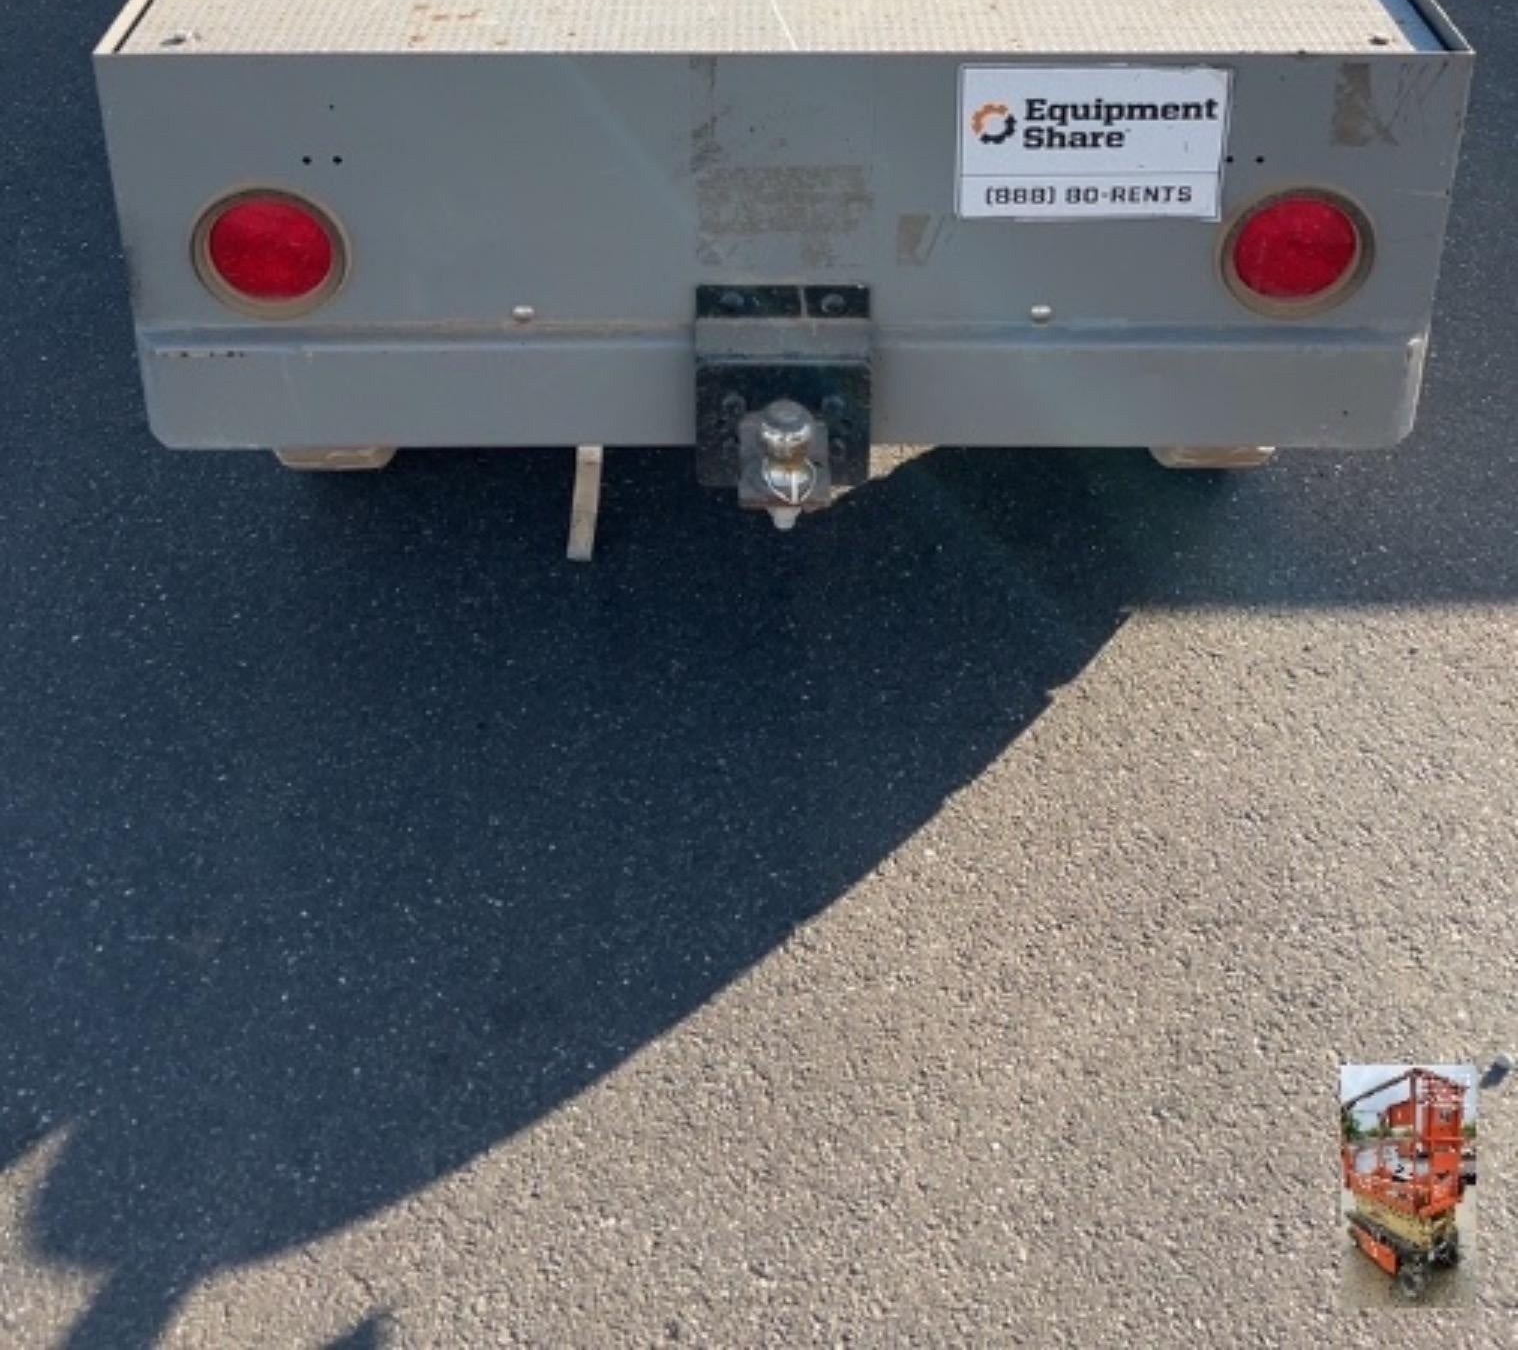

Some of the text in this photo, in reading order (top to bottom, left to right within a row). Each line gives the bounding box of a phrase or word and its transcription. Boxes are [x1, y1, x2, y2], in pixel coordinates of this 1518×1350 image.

[1024, 98, 1219, 127] Equipment
[1022, 126, 1126, 149] Share
[985, 185, 1193, 206] (888) 80-RENTS
